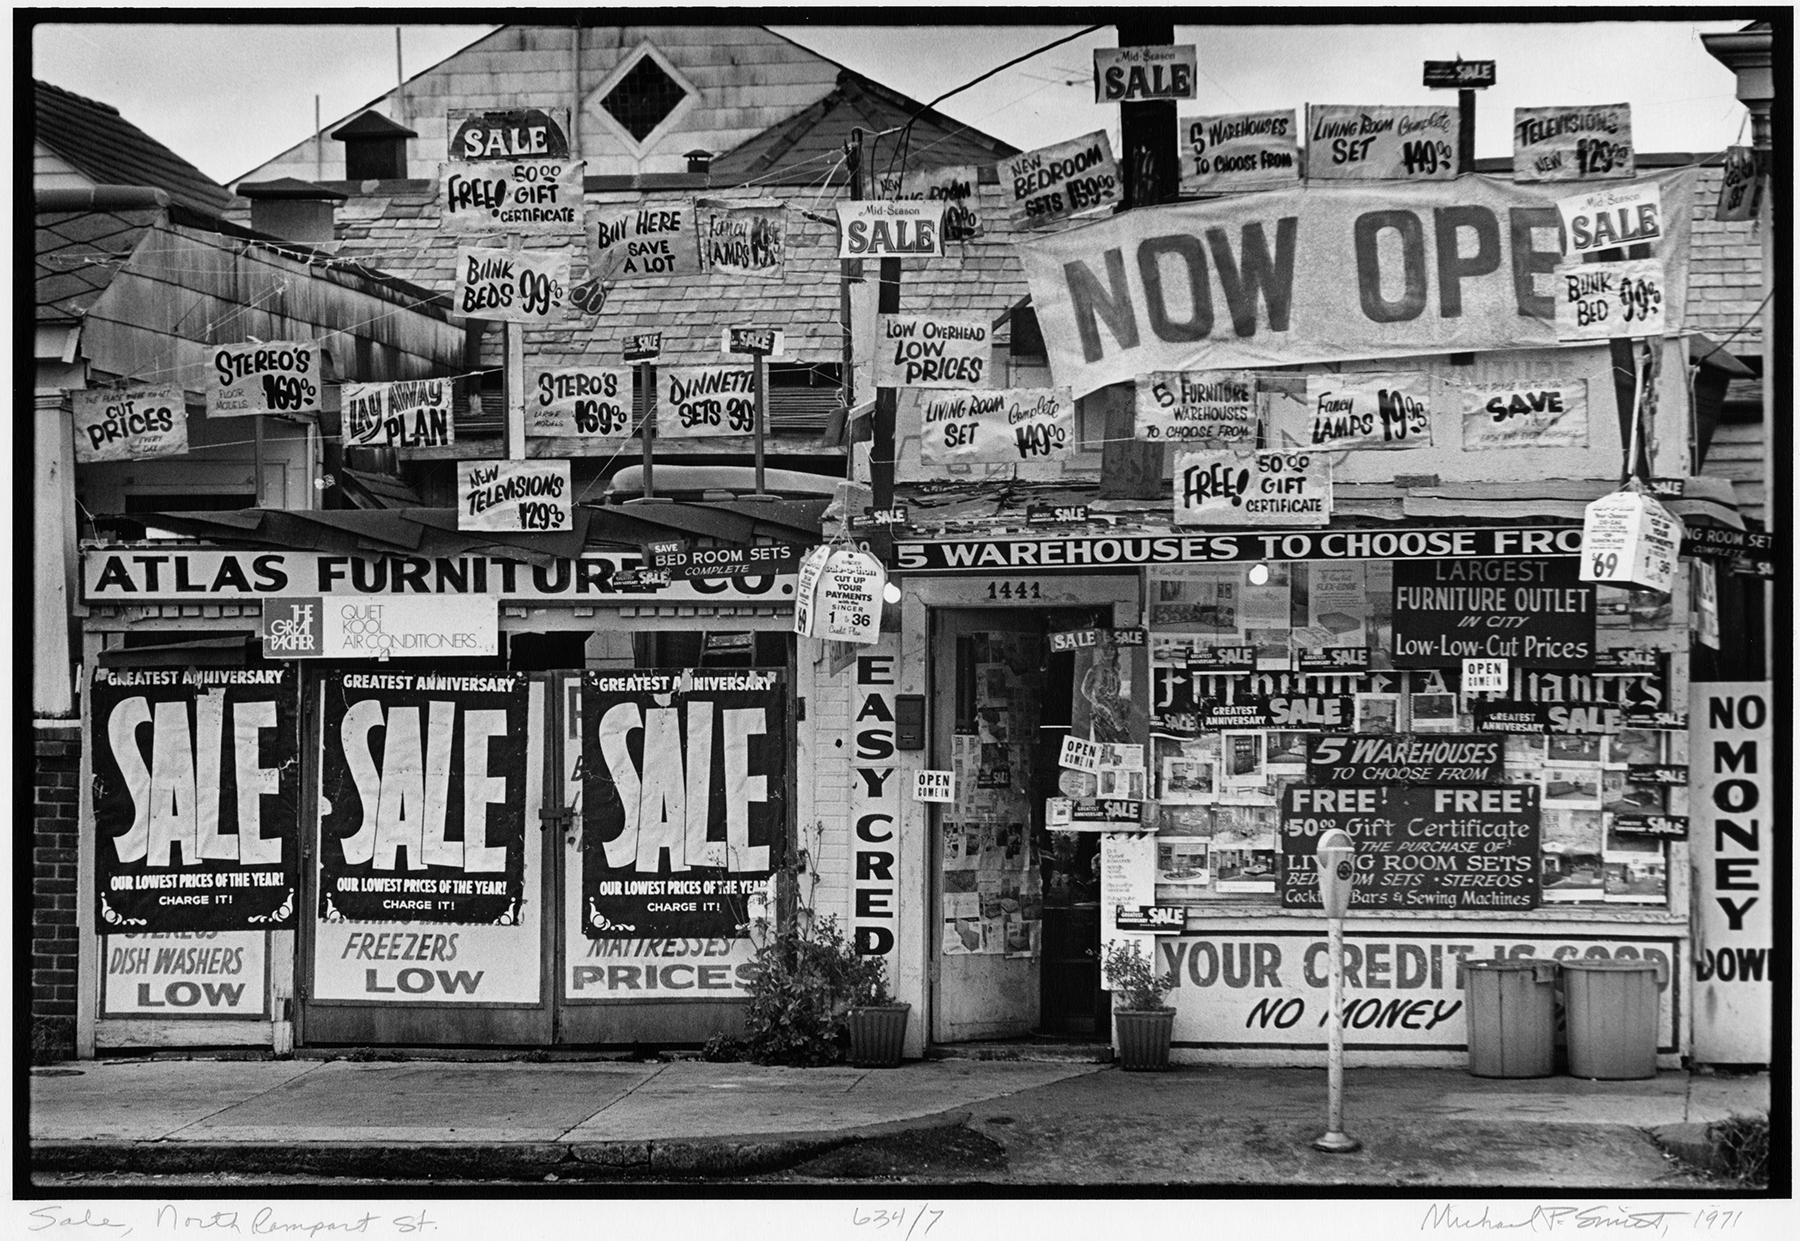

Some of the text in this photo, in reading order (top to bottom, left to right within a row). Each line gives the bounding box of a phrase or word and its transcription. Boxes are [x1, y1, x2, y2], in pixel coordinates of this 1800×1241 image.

[1105, 63, 1190, 99] SALE
[464, 126, 548, 158] SALE
[1190, 118, 1290, 155] 5 WAREHOUSES
[1332, 136, 1376, 164] SET
[1011, 154, 1042, 177] NEW
[1014, 144, 1103, 200] BEDROOM
[1196, 155, 1258, 175] TO CHOOSE
[448, 174, 506, 218] FREE!
[514, 184, 559, 203] GIFT
[1025, 193, 1063, 216] SETS
[500, 208, 575, 222] CERTIFICATE
[859, 205, 920, 216] Mid-Season
[598, 211, 681, 249] BUY HERE
[848, 219, 935, 253] SALE
[1572, 203, 1660, 250] SALE
[628, 241, 670, 256] SAVE
[624, 255, 675, 274] A LOT
[1063, 204, 1560, 363] NOW OPE
[462, 283, 514, 312] BEDS
[1577, 300, 1608, 327] BED
[887, 320, 985, 341] LOW OVERHEAD
[895, 339, 945, 365] LOW
[215, 347, 311, 387] STEREO'S
[906, 357, 983, 384] PRICES
[1153, 382, 1175, 407] 5
[105, 400, 135, 420] CUT
[678, 400, 721, 428] SETS
[926, 395, 1005, 422] LIVING ROOM
[1173, 406, 1248, 421] WAREHOUSES
[1486, 391, 1564, 422] SAVE
[86, 406, 173, 451] PRICES
[349, 397, 449, 447] LAY PLAN
[1147, 424, 1249, 438] TO CHOOSE FROM
[1312, 413, 1374, 444] LAMPS
[944, 422, 980, 448] SET
[469, 464, 499, 489] NEW
[1183, 462, 1250, 508] FREE!
[1261, 476, 1307, 495] GIFT
[466, 472, 564, 515] TELEVISIONS
[1245, 498, 1322, 513] CERTIFICATE
[654, 543, 678, 553] SAVE
[655, 546, 790, 566] BED ROOM SETS
[898, 529, 1583, 567] 5 WAREHOUSES TO CHOOSE FRO
[94, 554, 288, 593] ATLAS
[685, 564, 750, 576] COMPLETE
[834, 574, 866, 584] CUT UP
[1436, 560, 1549, 581] LARGEST
[825, 590, 872, 602] PAYMENTS
[837, 583, 862, 592] YOUR
[987, 581, 1042, 599] 1441
[832, 604, 864, 612] SINGER
[1396, 586, 1590, 613] FURNITURE OUTLET
[290, 604, 314, 621] THE
[340, 604, 384, 621] QUIET
[1457, 616, 1530, 627] IN CITY
[271, 620, 314, 635] GREAT
[342, 620, 384, 634] KOOL
[1114, 630, 1143, 645] SALE
[342, 634, 363, 648] AIR
[1055, 630, 1097, 650] SALE
[1396, 634, 1588, 658] Low-Low-Cut Prices
[1217, 647, 1253, 665] SALE
[1331, 649, 1367, 666] SALE
[1468, 662, 1501, 675] OPEN
[343, 674, 515, 693] GREATEST ANNIVERSARY
[599, 676, 670, 692] GREATEST
[1206, 697, 1342, 726] ANNIVERSARY SALE
[1212, 705, 1258, 716] GREATEST
[1482, 706, 1621, 734] ANNIVERSARY SALE
[1490, 713, 1536, 722] GREATEST
[1709, 694, 1766, 729] NO
[855, 655, 895, 798] EASY
[1067, 740, 1096, 758] OPEN
[1311, 737, 1498, 765] 5 WAREHOUSES
[107, 692, 283, 867] SALE
[918, 773, 950, 787] OPEN
[1331, 766, 1489, 780] TO CHOOSE FROM
[340, 699, 508, 873] SALE
[599, 701, 770, 873] SALE
[917, 786, 949, 798] COME IN
[1104, 801, 1139, 819] SALE
[1292, 786, 1535, 812] FREE! FREE!
[1346, 818, 1530, 838] Gift Certificate
[1712, 740, 1760, 931] MONEY
[1360, 841, 1478, 852] THE PURCHASE
[1383, 855, 1532, 871] ROOM SETS
[111, 871, 285, 890] OUR LOWEST PRICES OF THE YEAR!
[1380, 873, 1523, 887] SETS STEREOS
[159, 894, 233, 905] CHARGE IT!
[1351, 889, 1531, 908] Bars Sewing Machines
[1148, 907, 1185, 924] SALE
[341, 931, 460, 962] FREEZERS
[108, 947, 244, 975] DISH WASHERS
[1161, 941, 1475, 989] YOUR CREDIT
[366, 967, 485, 994] LOW
[572, 964, 762, 991] PRICES
[138, 981, 246, 1007] LOW
[1245, 997, 1463, 1029] NO MONEY
[156, 1204, 240, 1233] North
[392, 1211, 438, 1232] St.
[1693, 1206, 1744, 1230] 1971
